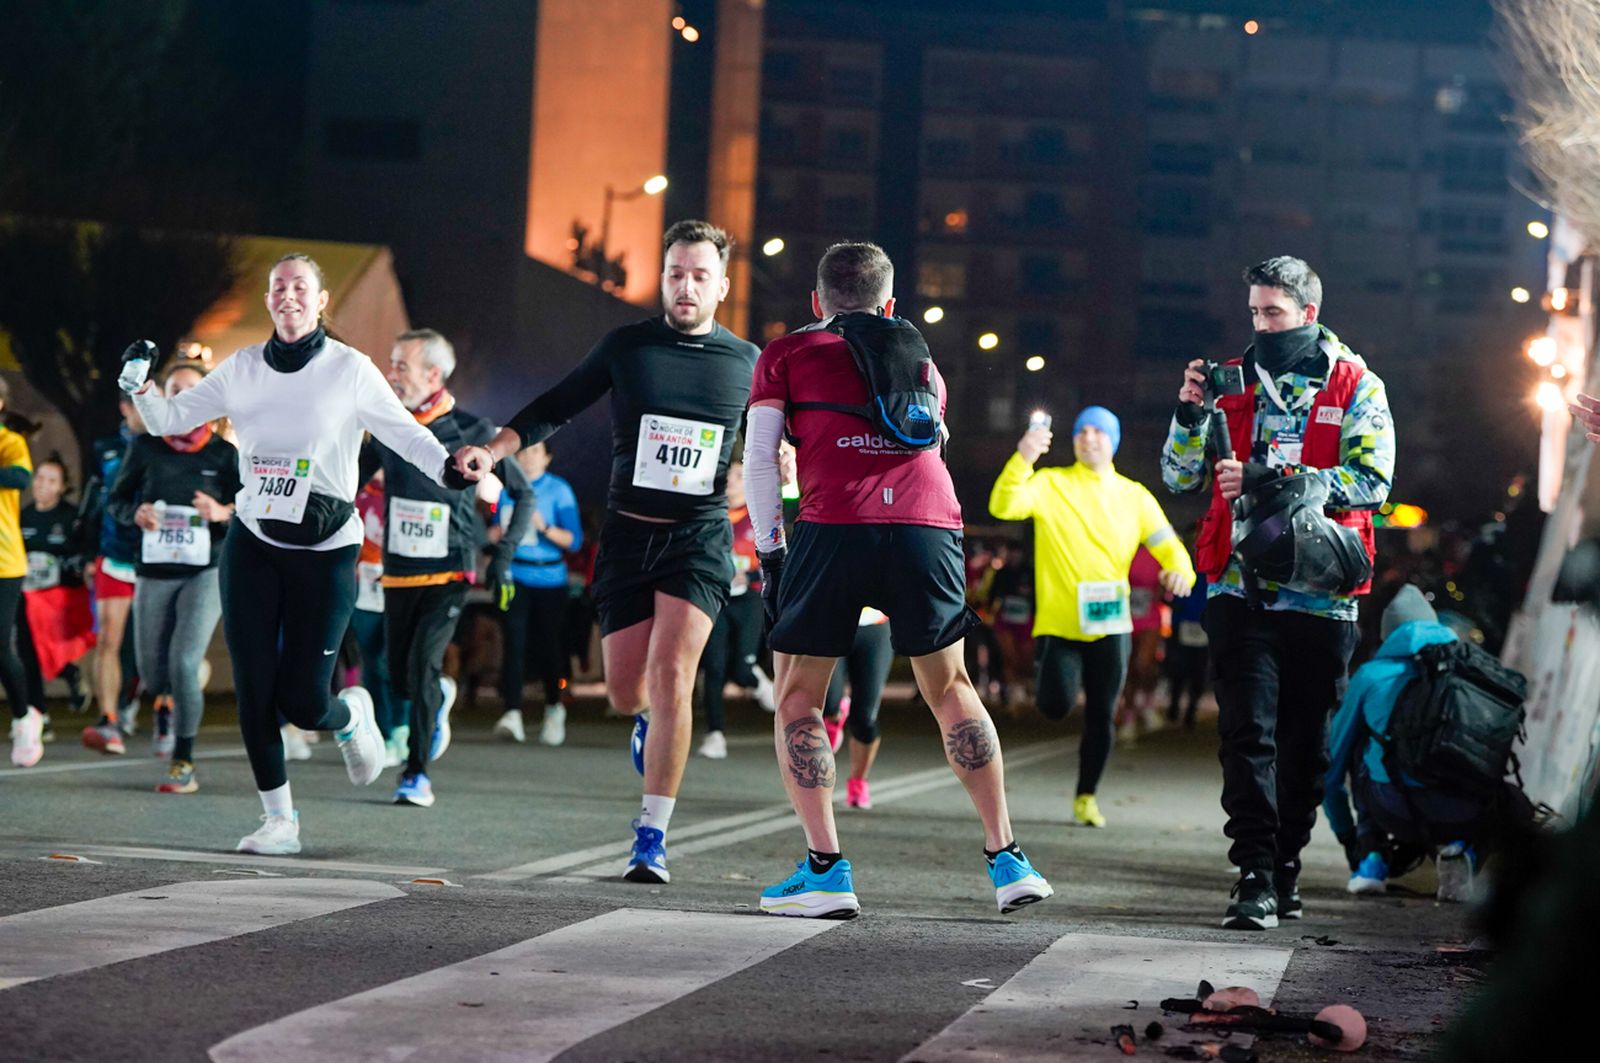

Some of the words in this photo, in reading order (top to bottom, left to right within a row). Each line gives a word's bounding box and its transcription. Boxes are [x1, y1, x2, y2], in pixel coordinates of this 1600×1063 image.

[648, 432, 664, 441] SAN
[666, 435, 692, 445] ANTON
[660, 426, 682, 435] NOCHE
[684, 428, 693, 436] DE
[656, 444, 702, 469] 4107
[258, 476, 297, 497] 7480
[158, 528, 194, 544] 7663
[782, 881, 805, 895] HOKA
